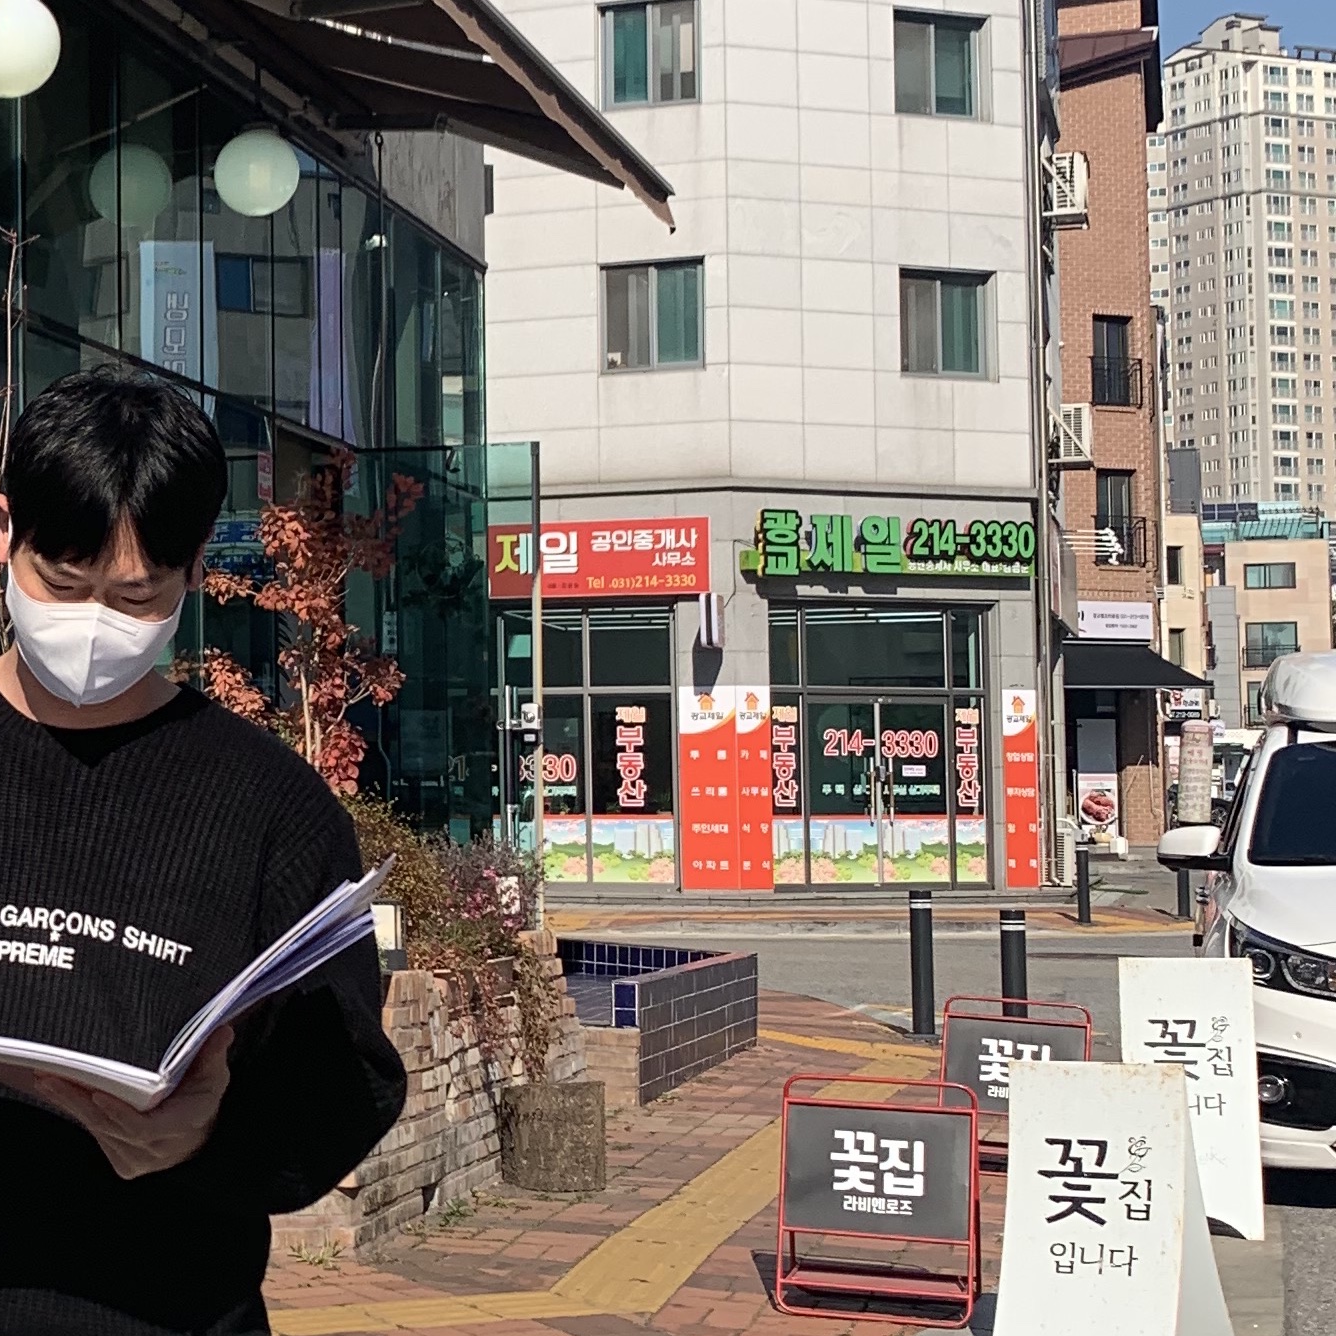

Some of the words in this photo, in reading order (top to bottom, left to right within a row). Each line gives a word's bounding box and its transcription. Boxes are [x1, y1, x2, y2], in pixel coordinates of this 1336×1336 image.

[494, 531, 579, 575] 제일
[590, 528, 698, 552] 공인중개사
[652, 551, 697, 567] 사무소
[912, 519, 1035, 559] 214-3330
[586, 576, 605, 590] Tel
[616, 725, 647, 807] 부동산
[773, 725, 798, 808] 부동산
[956, 727, 980, 808] 부동산
[0, 904, 116, 942] GARÇONS
[122, 926, 192, 966] SHIRT
[829, 1129, 925, 1196] 꽃집
[1037, 1137, 1152, 1227] 꽃집
[843, 1194, 913, 1215] 라비엔로즈
[1049, 1241, 1139, 1277] 입니다
